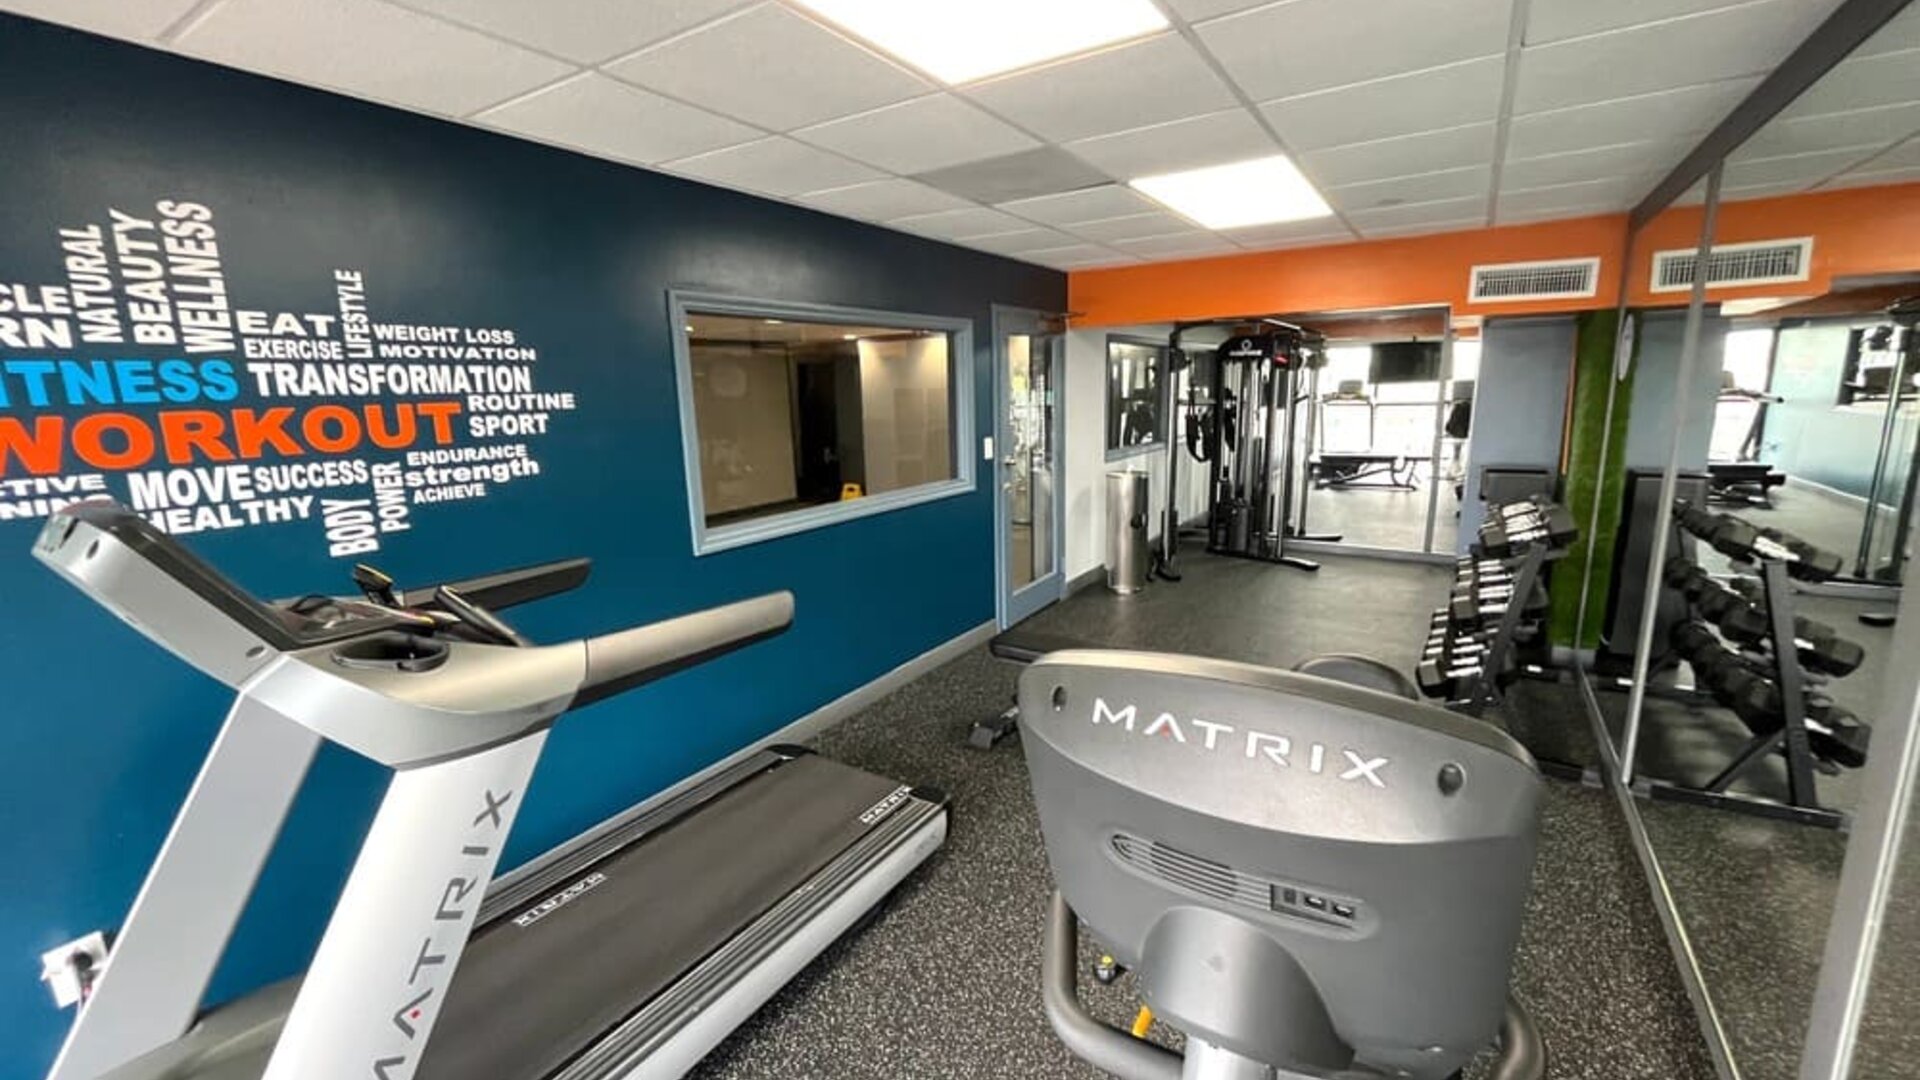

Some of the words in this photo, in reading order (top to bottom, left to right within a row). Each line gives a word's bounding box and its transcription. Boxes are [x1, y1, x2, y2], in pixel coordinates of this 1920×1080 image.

[58, 222, 125, 343] NATURAL
[108, 206, 178, 345] BEAUTY
[156, 200, 236, 353] WELLNESS
[235, 310, 335, 336] EAT
[334, 269, 374, 359] LIFESTYLE
[0, 316, 74, 349] RN
[242, 337, 344, 361] EXERCISE
[370, 323, 460, 344] WEIGHT
[464, 328, 516, 346] LOSS
[379, 344, 537, 362] MOTIVATION
[246, 362, 532, 397] TRANSFORMATION
[466, 391, 577, 413] ROUTINE
[0, 404, 461, 477] WORKOUT
[468, 413, 550, 438] SPORT
[404, 457, 540, 486] strength
[406, 444, 529, 466] ENDURANCE
[127, 464, 255, 511] MOVE
[252, 458, 370, 494] SUCCESS
[412, 482, 486, 504] ACHIEVE
[0, 493, 114, 520] NIN
[370, 460, 412, 534] POWER
[320, 498, 380, 558] BODY
[1091, 697, 1389, 790] MATRIX
